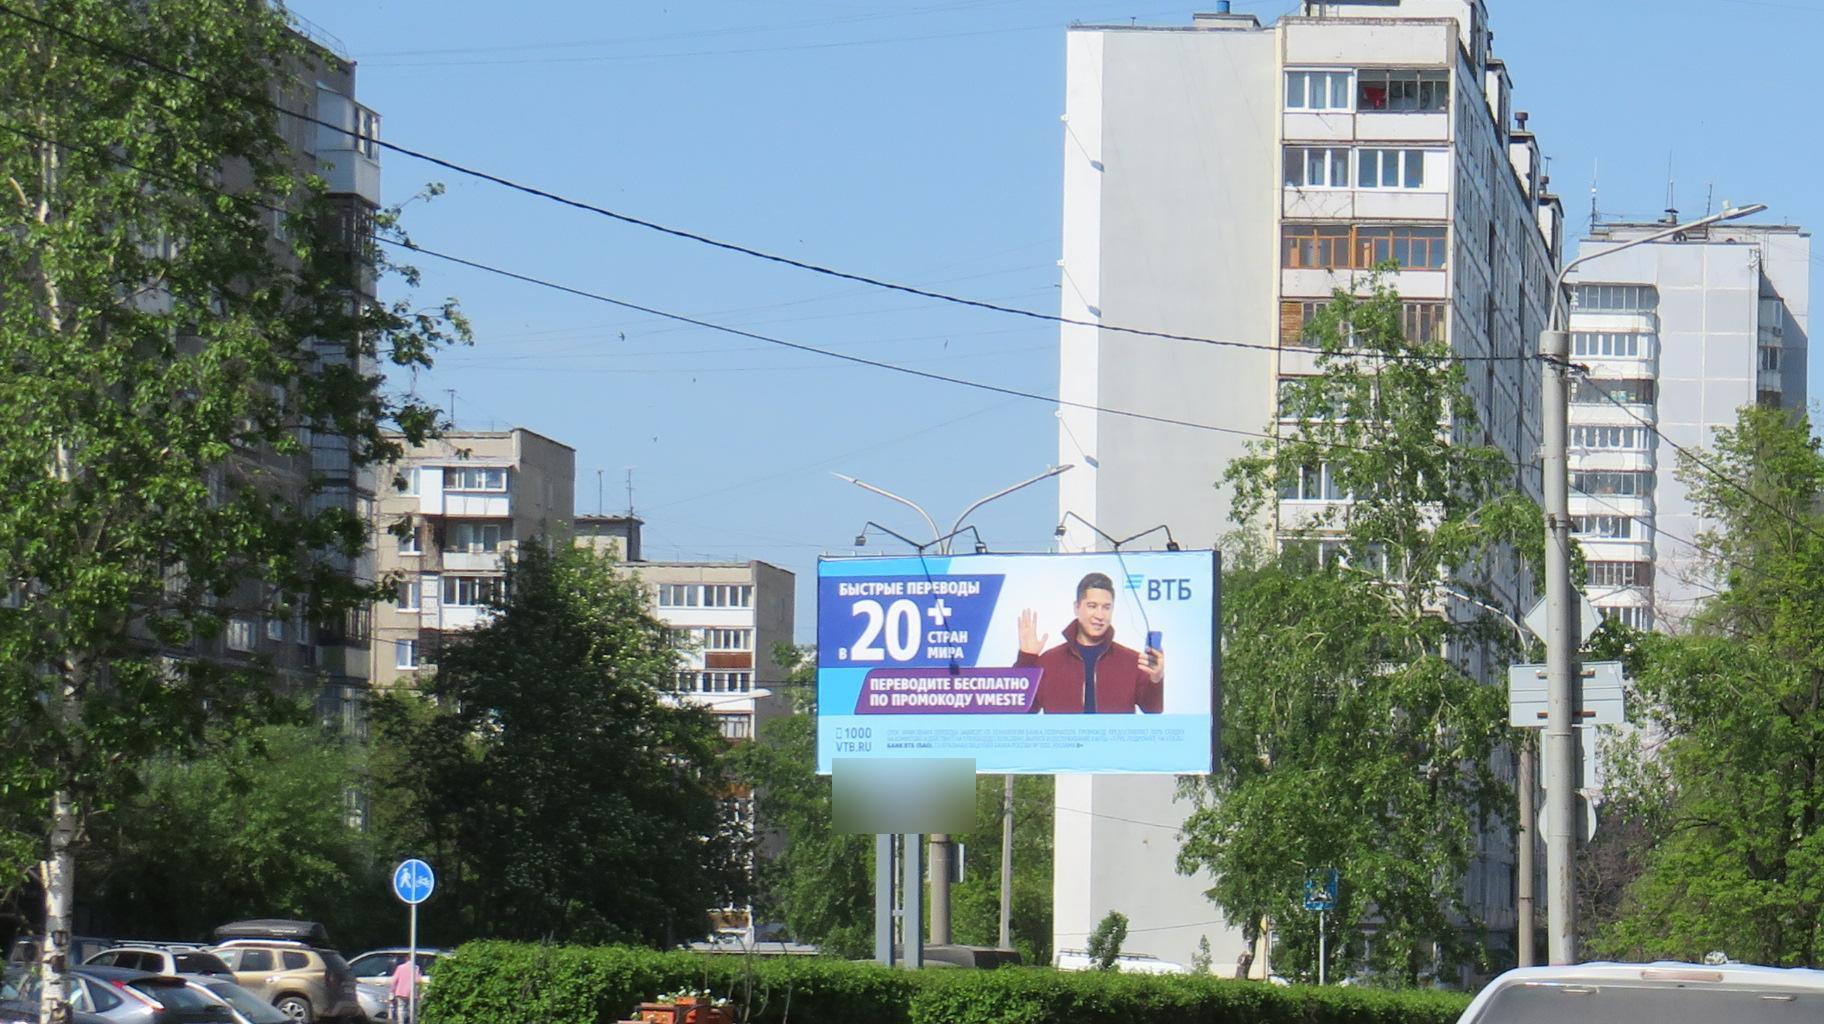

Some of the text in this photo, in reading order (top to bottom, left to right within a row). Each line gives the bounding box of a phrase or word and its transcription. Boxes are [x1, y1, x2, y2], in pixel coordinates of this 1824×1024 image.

[839, 581, 980, 597] БЫСТРЫЕ ПЕРЕВОДЫ
[1148, 579, 1192, 600] ВТБ
[927, 631, 968, 643] СТРАН
[927, 647, 964, 659] МИРА
[870, 677, 1029, 692] ПЕРЕВОДИТЕ БЕСПЛАТНО
[870, 693, 1026, 708] ПО ПРОМОКОДУ VMESTE
[844, 727, 872, 739] 1000
[836, 741, 872, 752] VTB.RU
